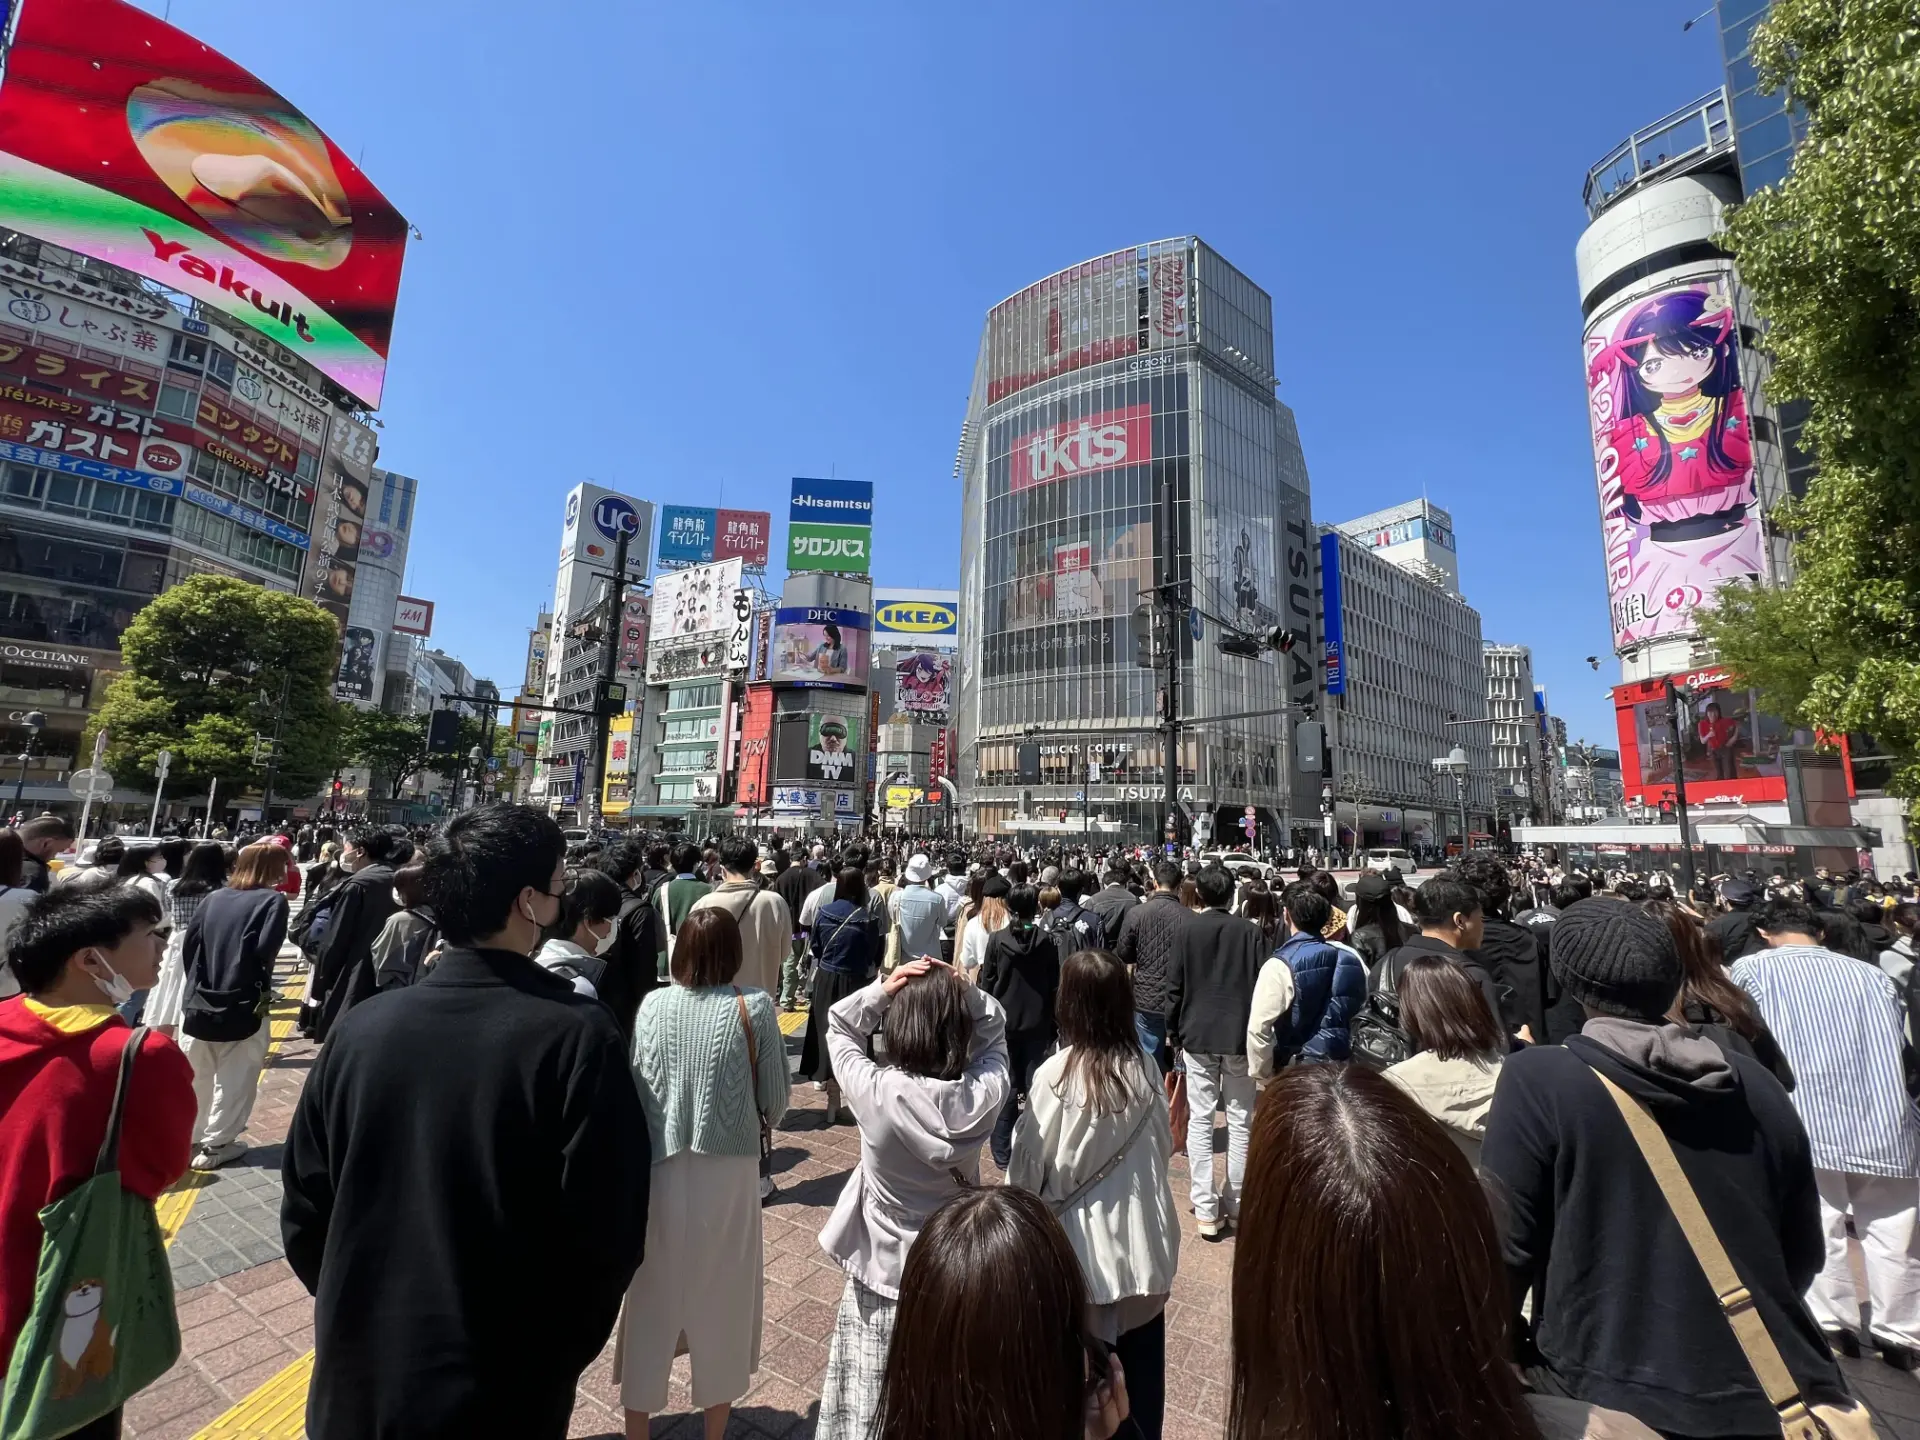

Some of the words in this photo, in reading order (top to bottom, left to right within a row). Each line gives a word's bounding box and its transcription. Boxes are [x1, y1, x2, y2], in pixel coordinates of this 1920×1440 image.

[0, 263, 168, 320] ゃぶしゃぶバイキング
[140, 226, 315, 342] Yakult
[59, 306, 158, 351] しゃぶ葉
[87, 405, 164, 436] ガスト
[267, 388, 322, 434] しゃぶ葉
[26, 420, 128, 460] ガスト
[199, 399, 294, 463] コンタクト
[1027, 421, 1128, 481] tkts
[152, 479, 170, 490] 6F
[266, 470, 307, 499] ガスト
[1599, 446, 1625, 518] ON
[792, 495, 871, 510] Hisamitsu
[230, 504, 309, 545] 英会話イーオン
[673, 517, 706, 532] 龍角散
[727, 521, 760, 536] 龍角散
[626, 556, 641, 567] ISA
[793, 536, 865, 558] サロンパス
[1604, 516, 1635, 594] AIR
[729, 588, 751, 666] もんじゃ
[808, 609, 837, 622] DHC
[883, 609, 950, 624] IKEA
[0, 645, 89, 665] 'OCCITANE
[1326, 640, 1340, 686] SEIBU
[810, 750, 853, 767] DMM
[1087, 743, 1134, 753] COFFEE
[821, 765, 842, 780] TV
[777, 790, 849, 806] 大盛堂店
